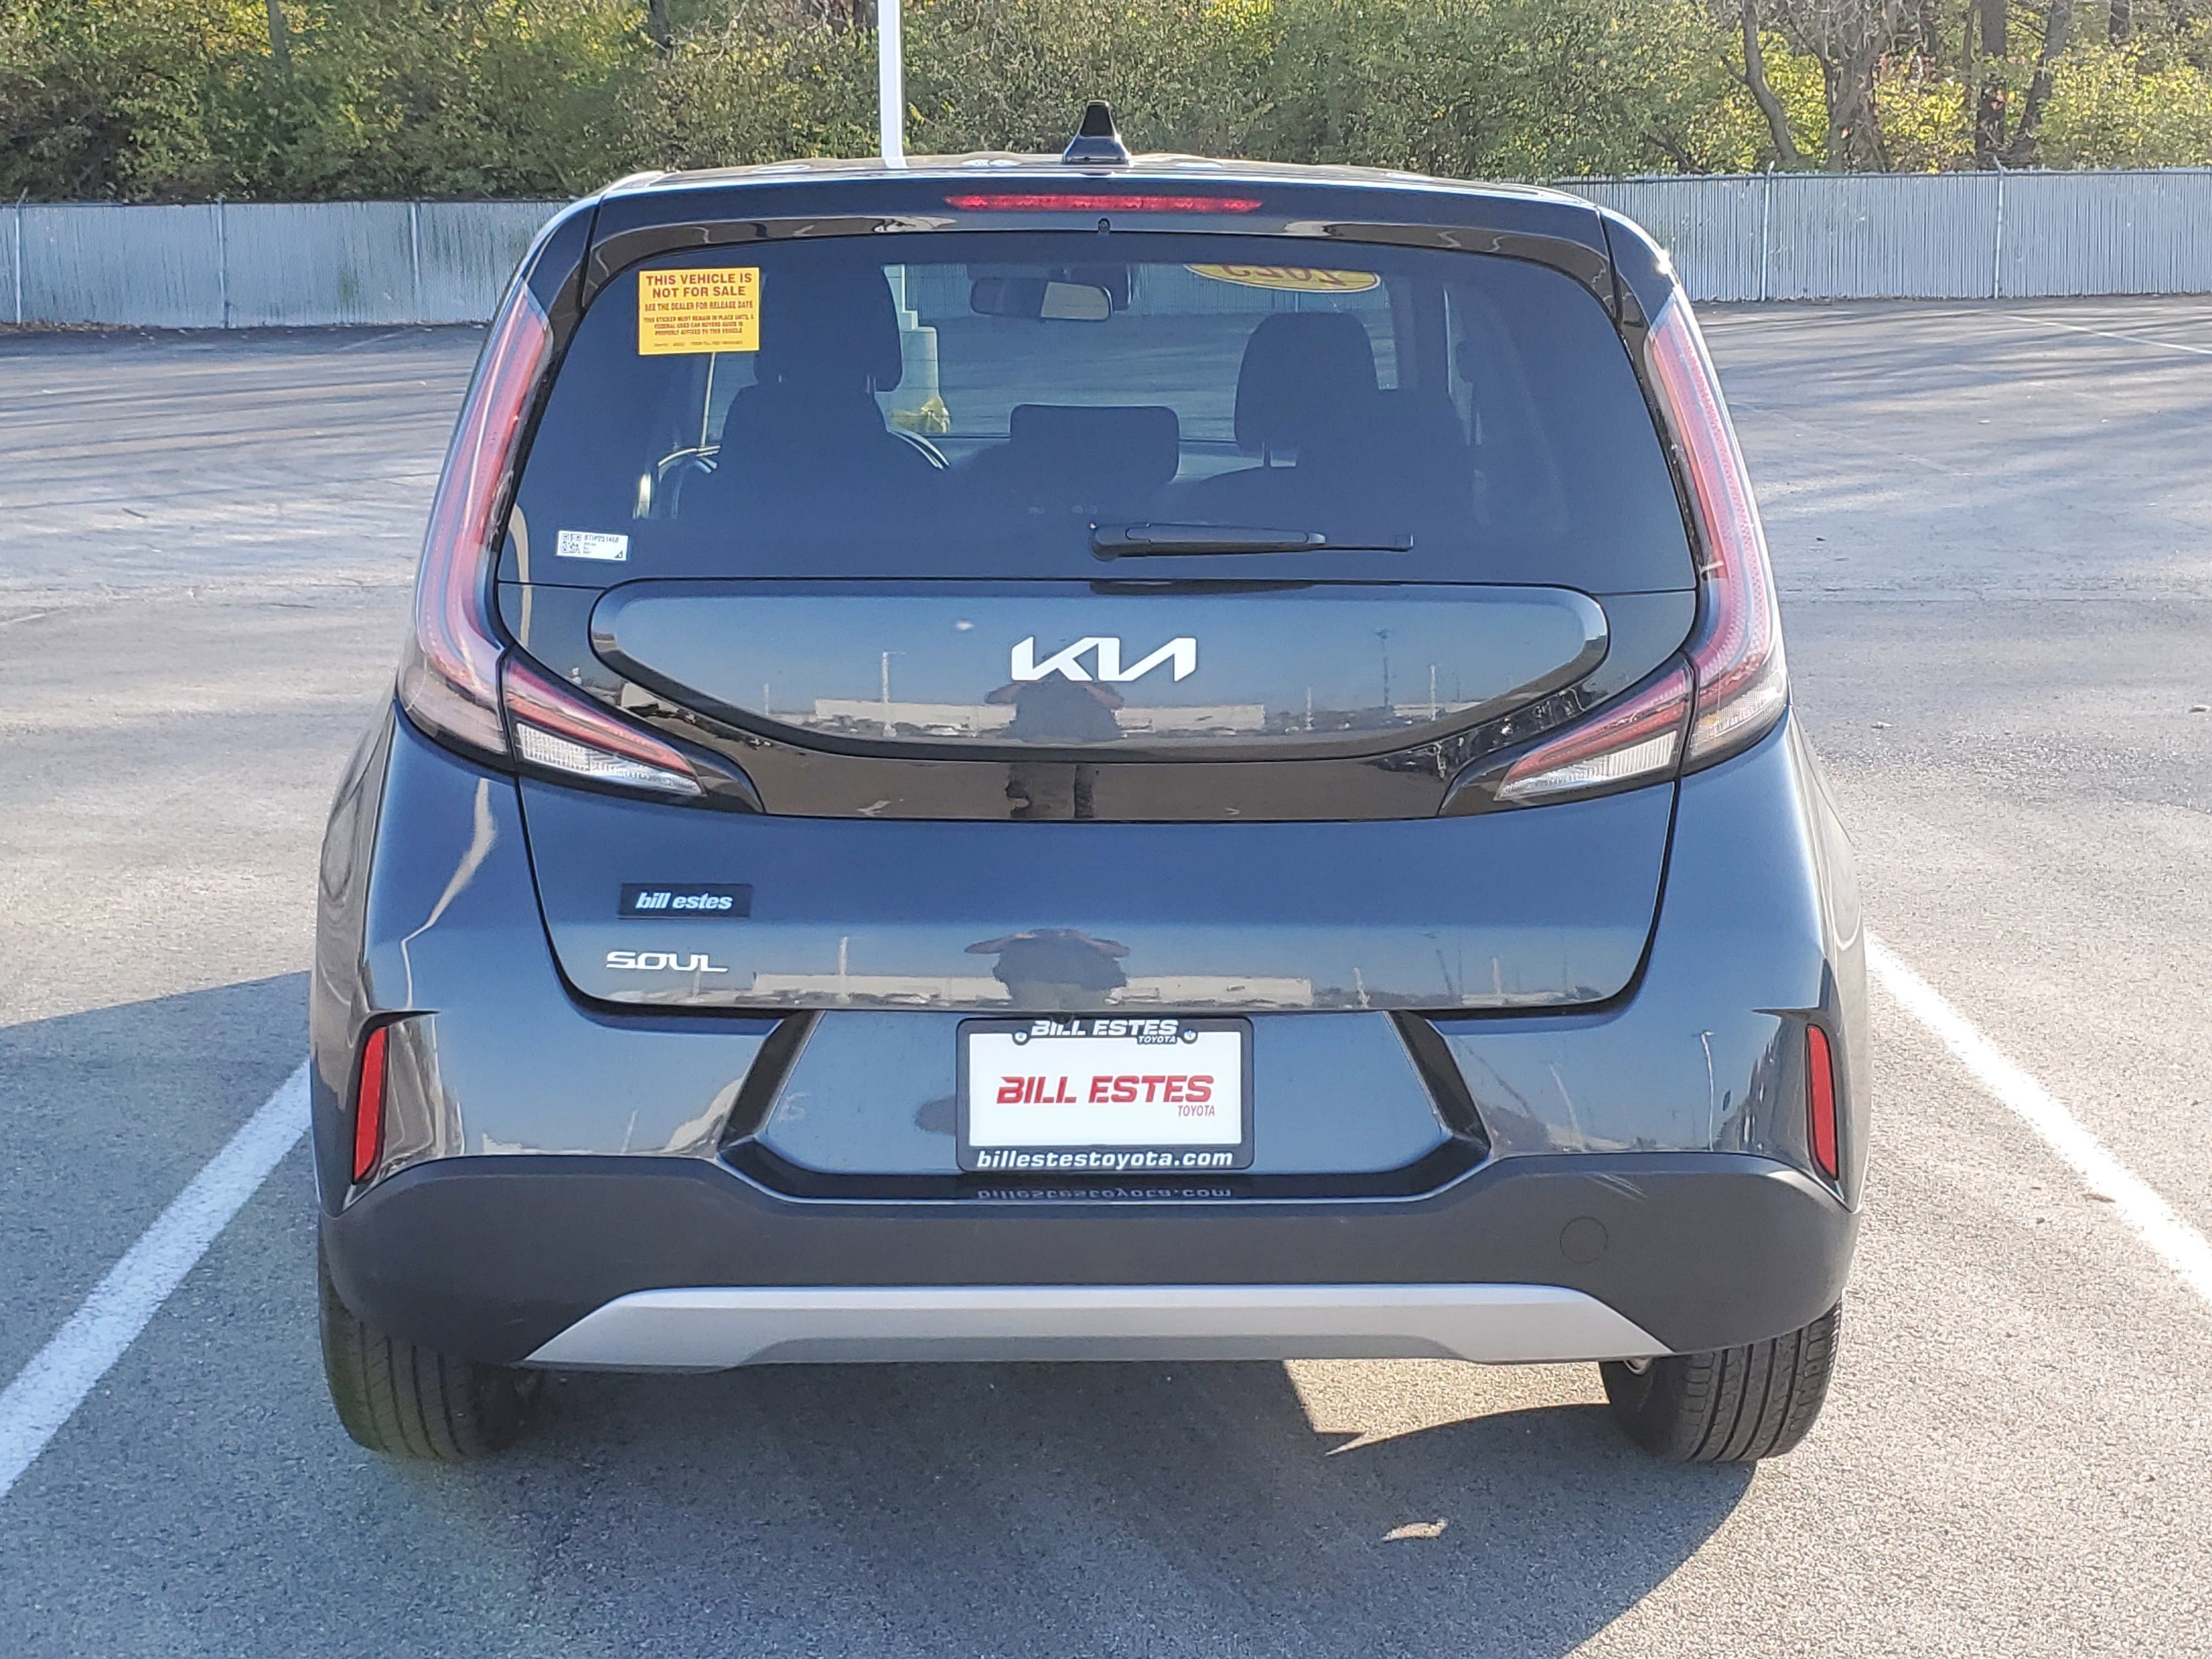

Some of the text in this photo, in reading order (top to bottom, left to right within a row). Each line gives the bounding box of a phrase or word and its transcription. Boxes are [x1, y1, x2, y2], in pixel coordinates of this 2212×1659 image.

[646, 273, 752, 286] THIS VEHICLE IS
[652, 286, 746, 298] NOT FOR SALE
[1011, 636, 1197, 681] KIA
[635, 892, 733, 910] bill estes
[606, 951, 729, 972] SOUL
[1031, 1019, 1179, 1036] BILL ESTES
[996, 1075, 1214, 1104] BILL ESTES
[1178, 1105, 1215, 1117] TOYOTA
[977, 1151, 1233, 1170] billestestoyota.com
